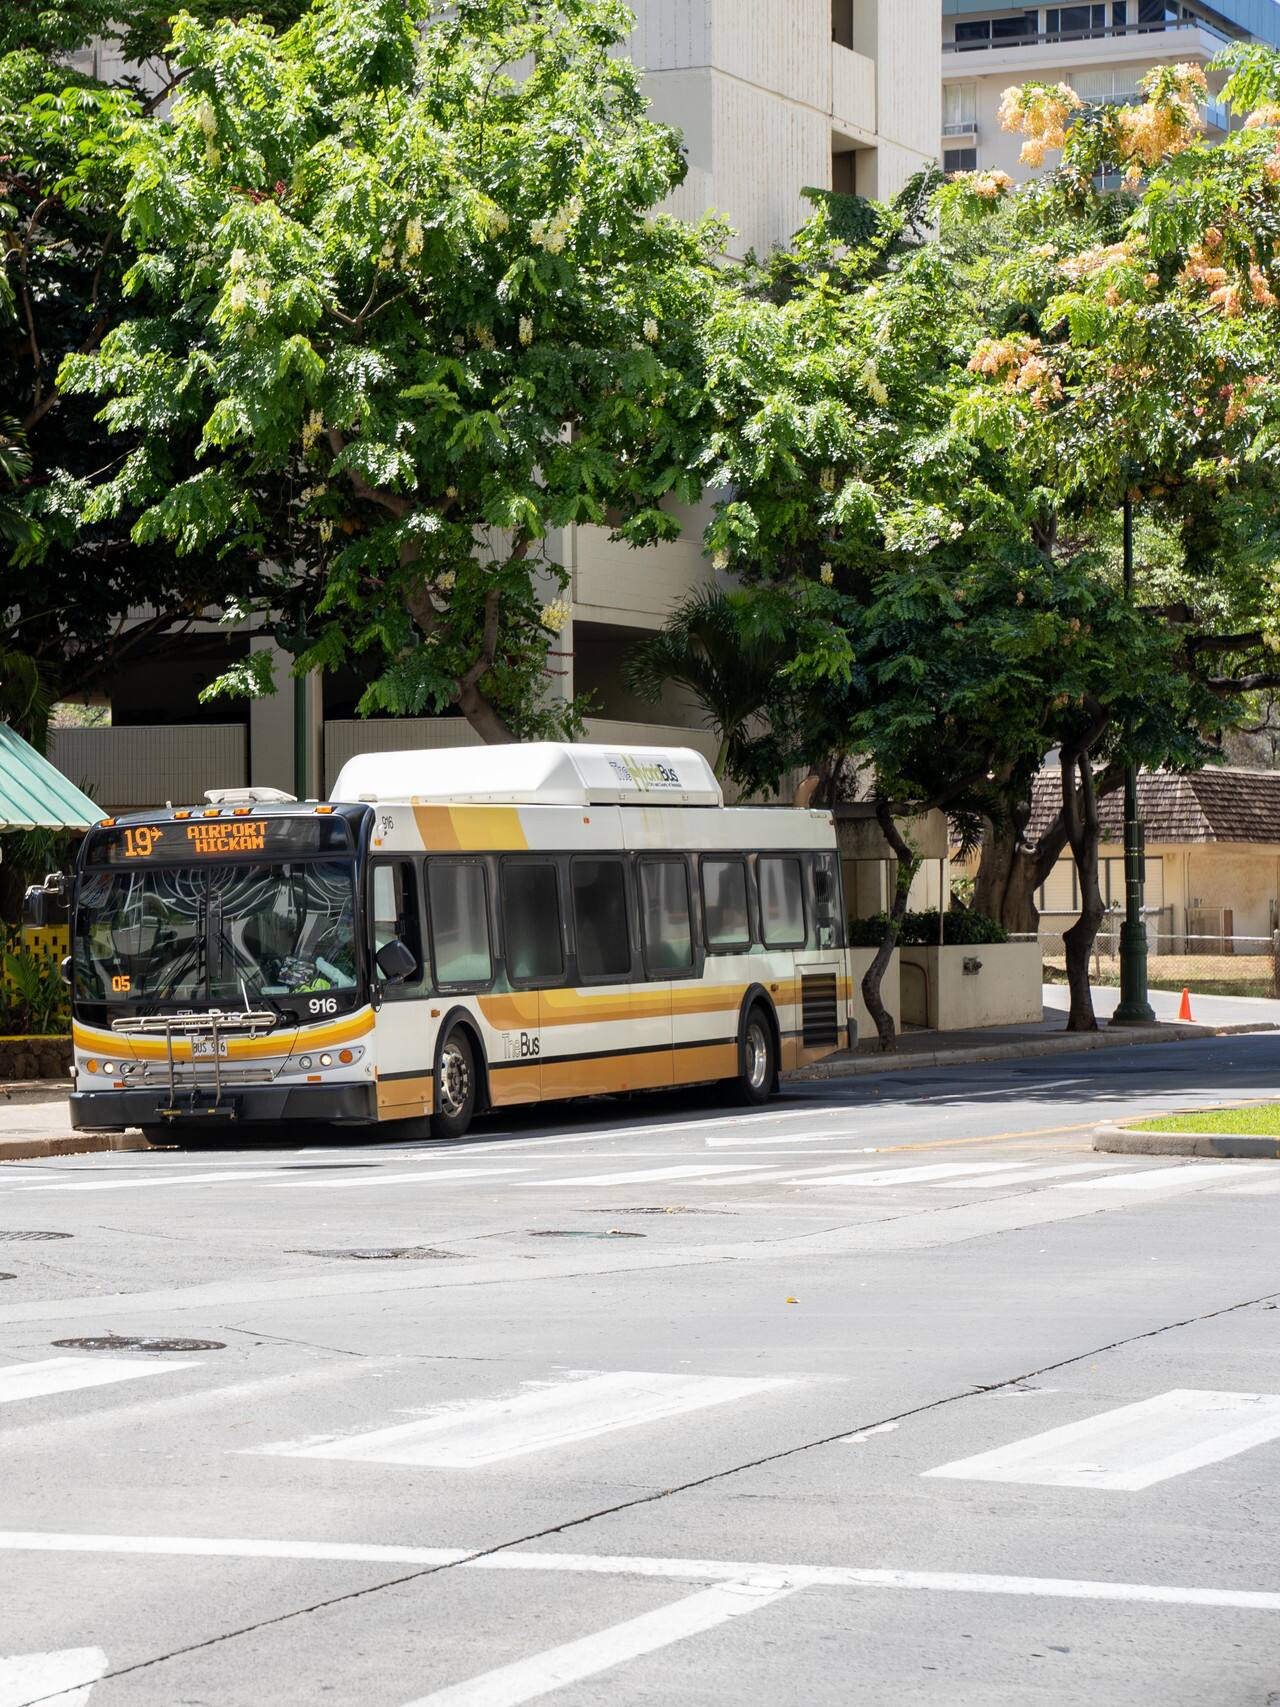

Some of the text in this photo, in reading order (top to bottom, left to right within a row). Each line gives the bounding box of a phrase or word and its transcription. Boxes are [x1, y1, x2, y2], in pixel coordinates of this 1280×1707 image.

[186, 821, 268, 840] AIRPORT
[381, 815, 394, 830] 916
[124, 826, 153, 857] 19
[195, 836, 265, 853] HICKAM
[112, 975, 131, 992] 05
[309, 998, 337, 1014] 916
[211, 1041, 226, 1053] 96
